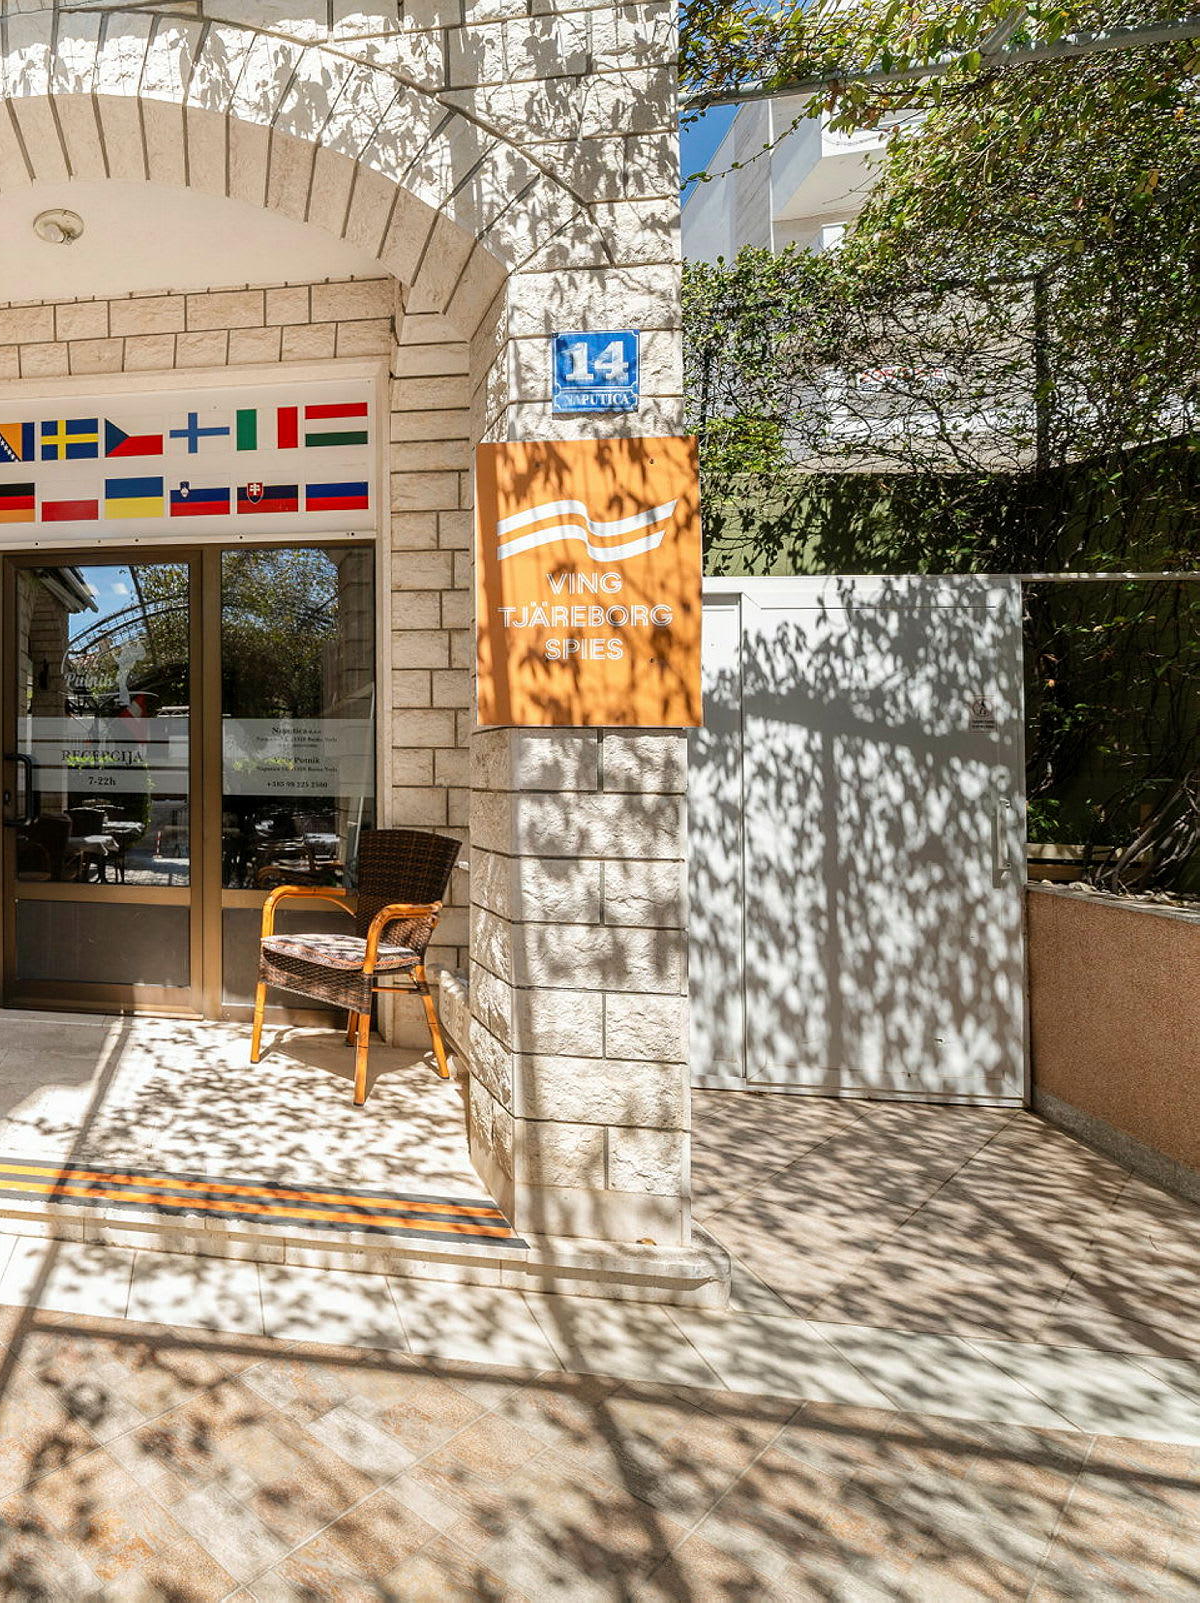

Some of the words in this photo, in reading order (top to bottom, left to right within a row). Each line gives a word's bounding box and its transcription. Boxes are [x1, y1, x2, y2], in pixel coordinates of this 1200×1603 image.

[561, 340, 630, 382] 14
[564, 392, 630, 406] NAPUTICA
[545, 571, 624, 595] VING
[497, 601, 674, 628] TJÄREBORG
[544, 637, 624, 661] SPIES
[88, 776, 117, 786] 7-22h
